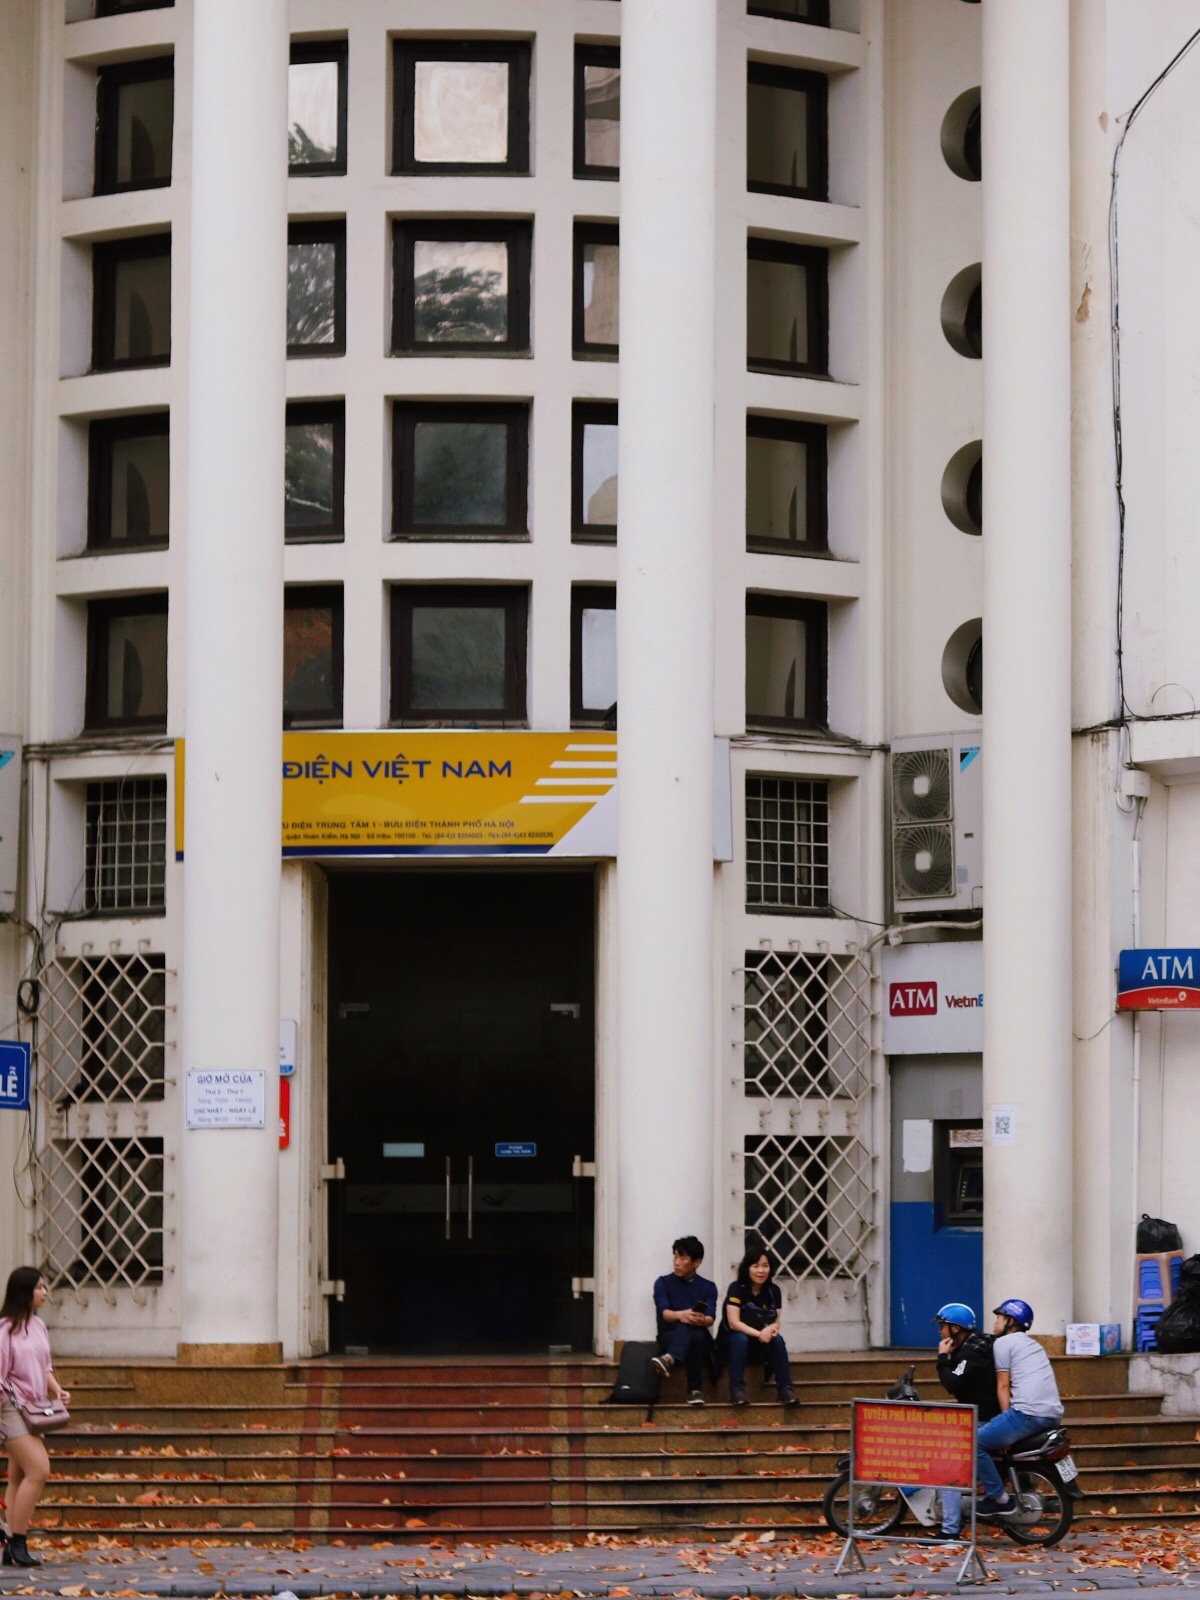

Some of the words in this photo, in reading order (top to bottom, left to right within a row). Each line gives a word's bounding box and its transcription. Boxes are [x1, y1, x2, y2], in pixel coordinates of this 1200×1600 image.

[282, 753, 353, 785] ĐIỆN
[361, 753, 431, 785] VIỆT
[442, 760, 512, 778] NAM
[316, 821, 346, 829] TRUNG
[1142, 955, 1194, 980] ATM
[891, 988, 935, 1010] ATM
